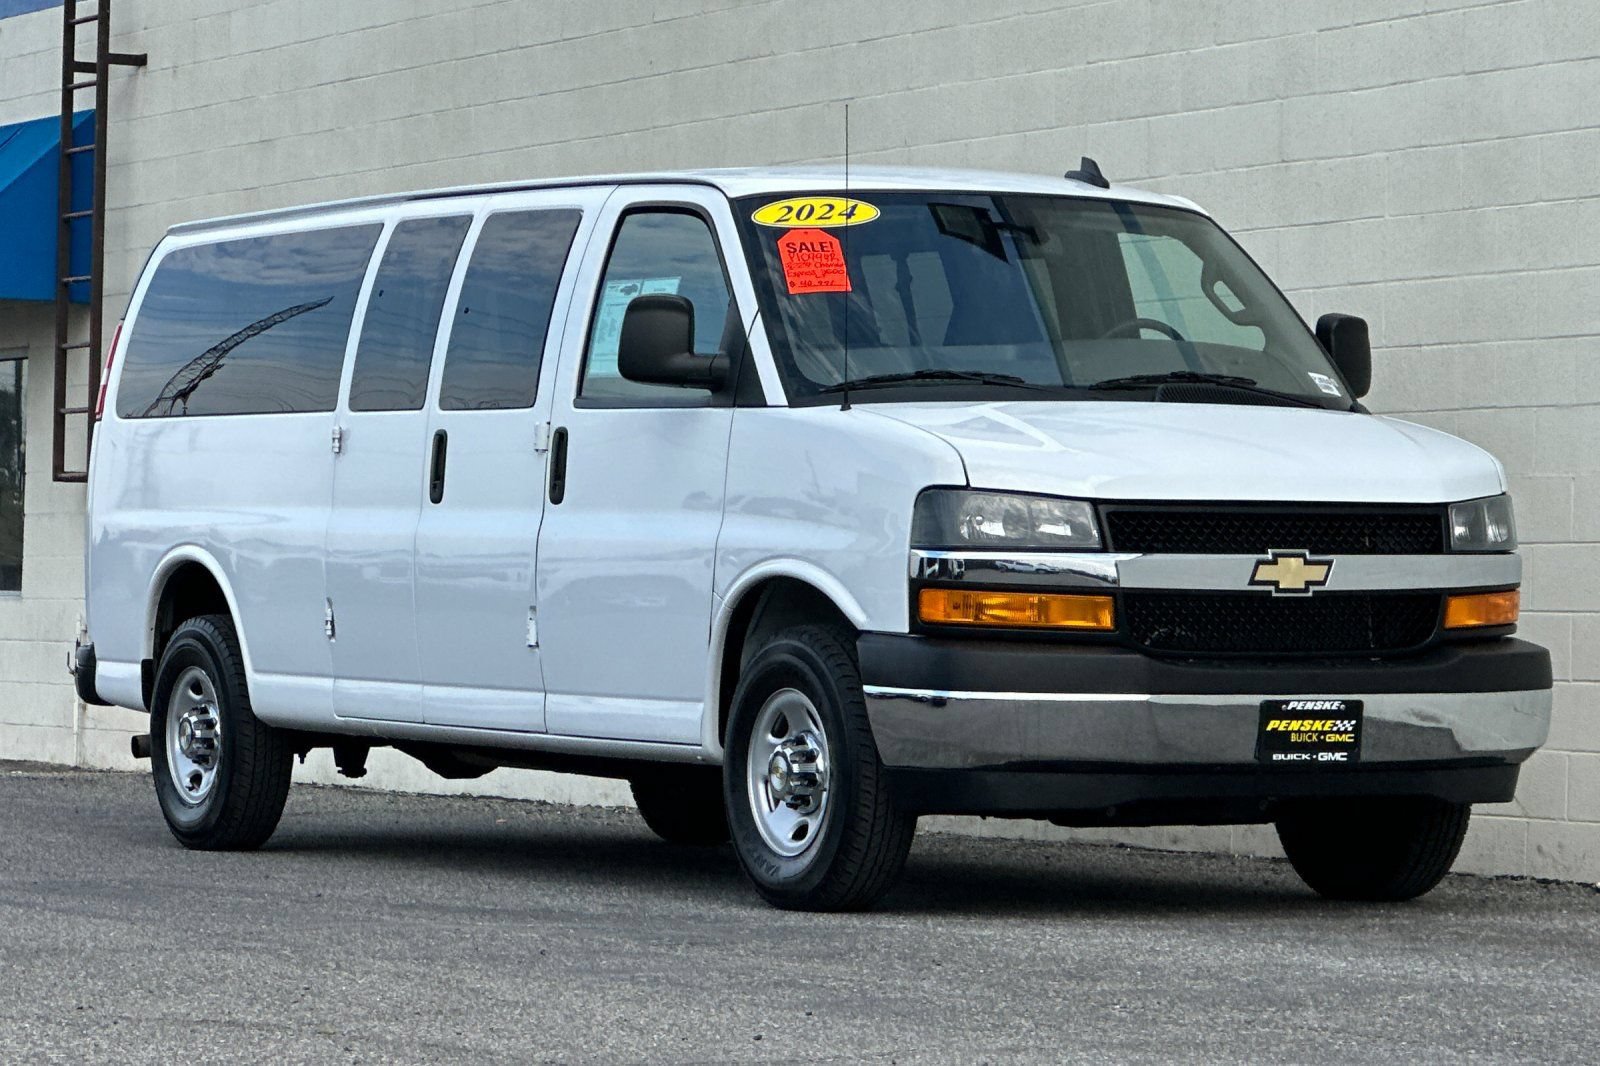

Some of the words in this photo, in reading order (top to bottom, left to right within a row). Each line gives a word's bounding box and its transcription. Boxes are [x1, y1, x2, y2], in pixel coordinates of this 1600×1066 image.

[774, 204, 859, 223] 2024
[785, 241, 834, 253] SALE!
[1287, 701, 1341, 710] PENSKE
[1266, 720, 1335, 731] PENSKE
[1290, 732, 1318, 742] BUICK
[1325, 733, 1355, 742] GMC
[1317, 752, 1348, 761] GMC
